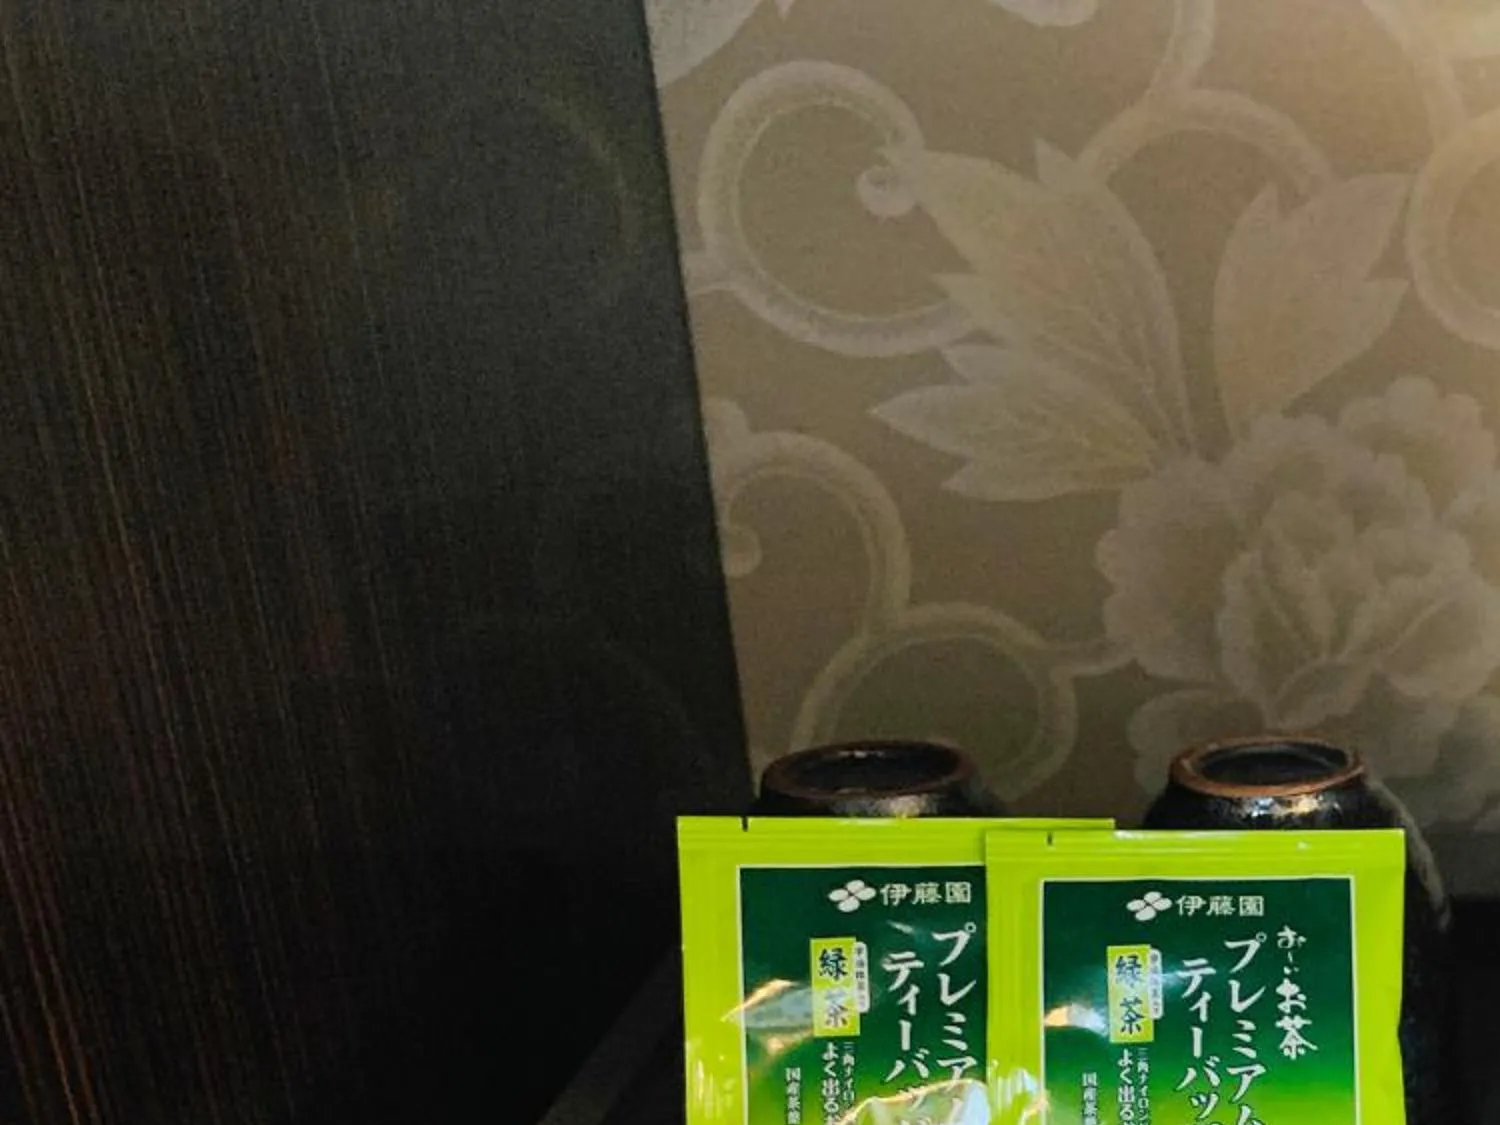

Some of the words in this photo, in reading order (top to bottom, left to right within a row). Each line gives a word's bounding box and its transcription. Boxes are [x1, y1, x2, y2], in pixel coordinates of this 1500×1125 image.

[880, 881, 972, 907] 伊藤園
[1176, 894, 1265, 917] 伊藤園
[1115, 954, 1145, 1036] 緑茶
